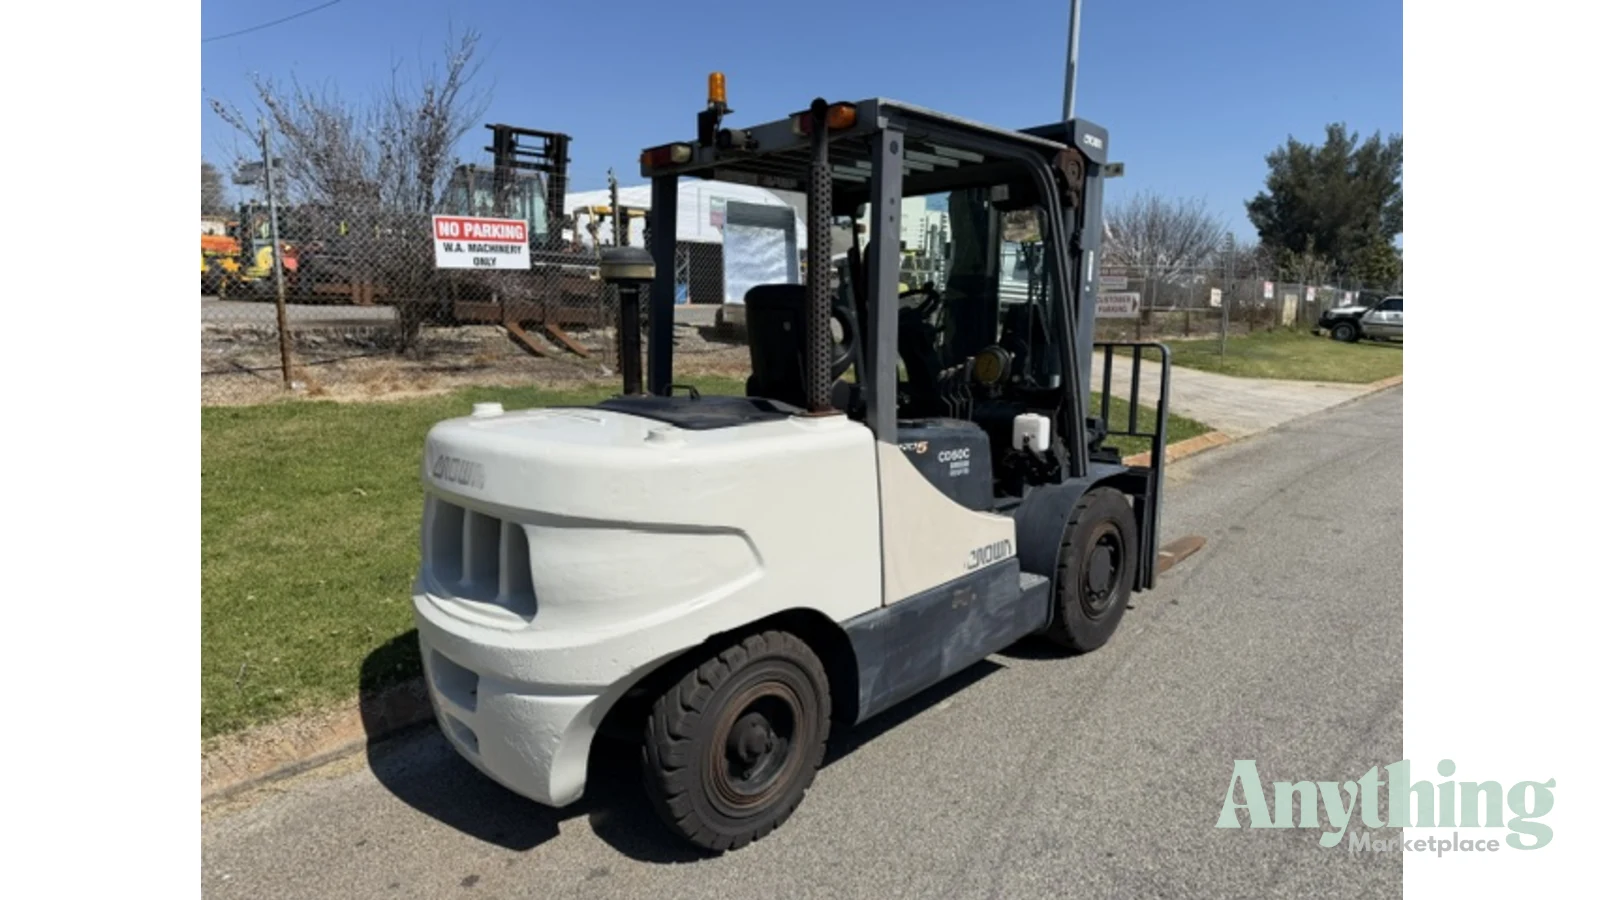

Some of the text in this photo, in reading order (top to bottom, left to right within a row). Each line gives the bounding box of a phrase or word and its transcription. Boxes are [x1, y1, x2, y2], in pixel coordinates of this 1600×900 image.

[438, 221, 523, 239] NO PARKING
[443, 242, 522, 254] W.A. MACHINERY
[472, 256, 497, 266] ONLY
